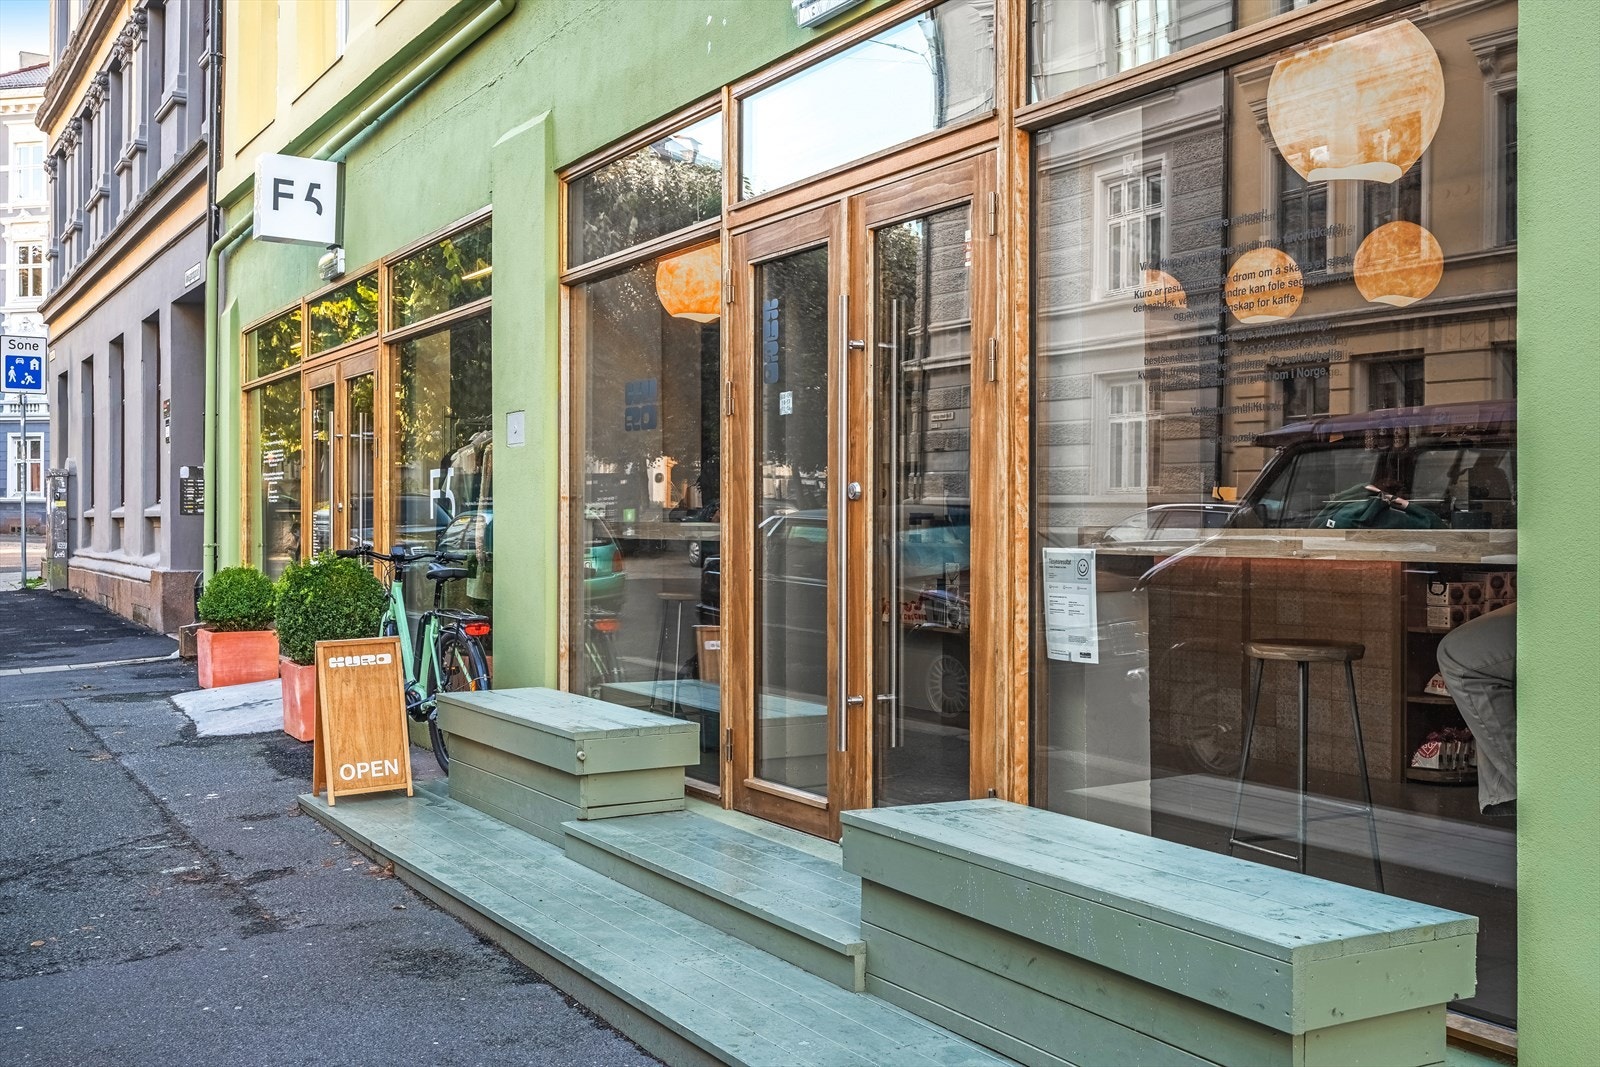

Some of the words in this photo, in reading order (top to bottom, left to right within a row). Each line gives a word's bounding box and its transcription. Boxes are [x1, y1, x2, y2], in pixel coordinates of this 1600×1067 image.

[1134, 287, 1153, 299] Kuro
[1258, 268, 1273, 278] om
[1248, 281, 1266, 294] kan
[1256, 297, 1269, 308] for
[1271, 293, 1298, 307] kaffe.
[8, 339, 39, 351] Sone
[1297, 366, 1329, 380] Norge.
[328, 653, 393, 669] KURO
[339, 758, 399, 781] OPEN
